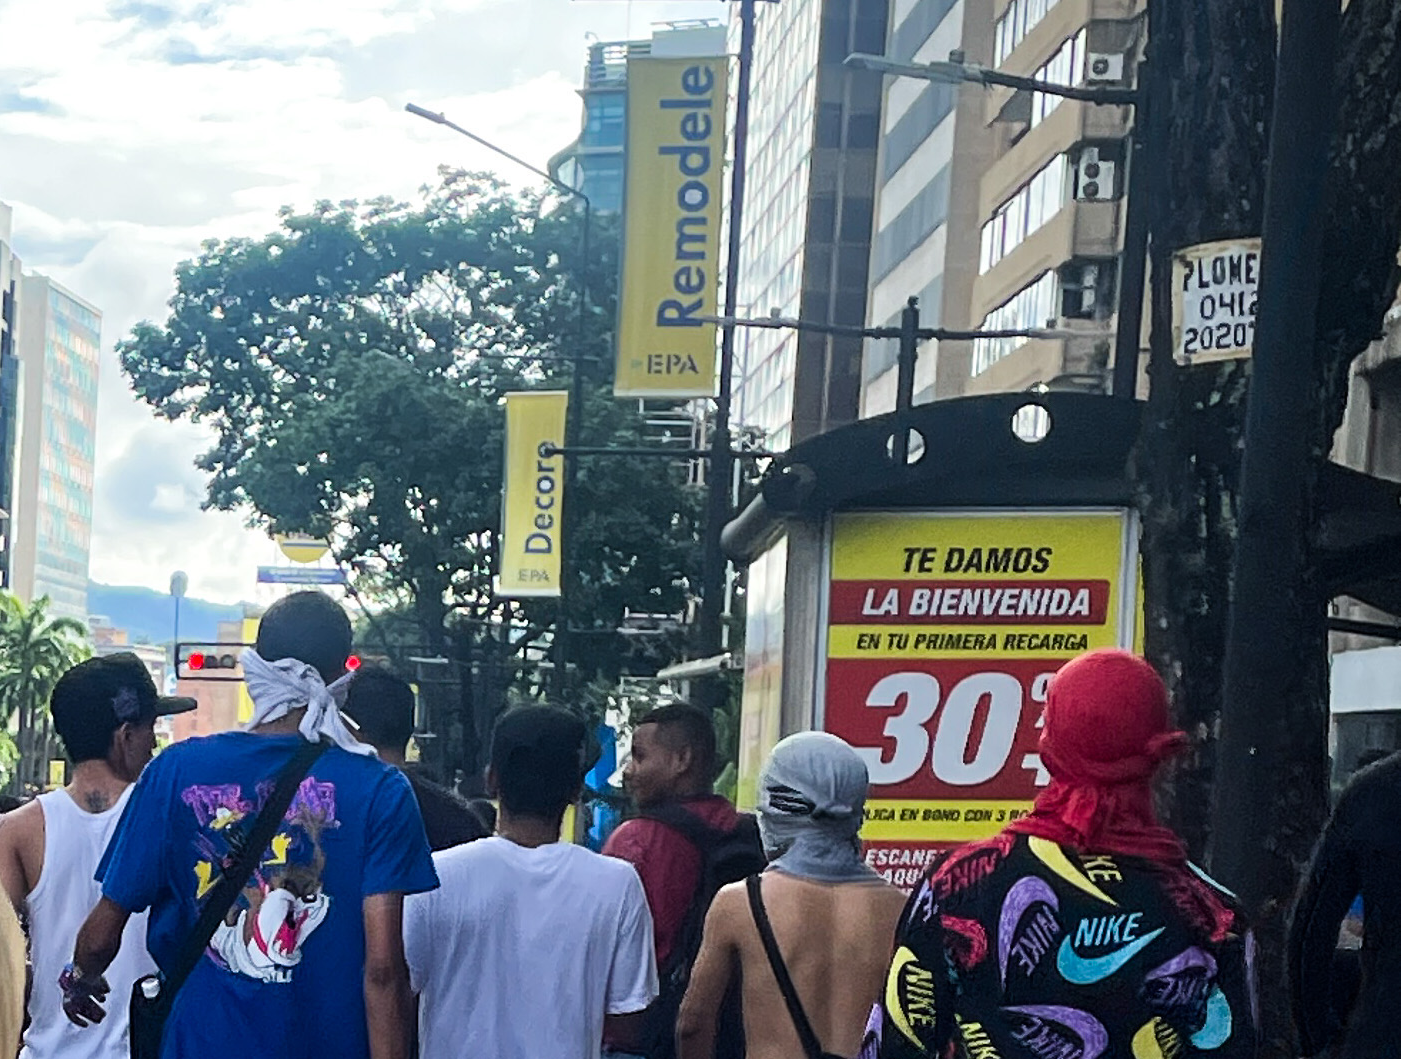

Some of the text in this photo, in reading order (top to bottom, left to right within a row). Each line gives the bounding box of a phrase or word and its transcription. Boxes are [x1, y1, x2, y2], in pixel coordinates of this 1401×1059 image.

[656, 65, 714, 327] Remodele
[1182, 254, 1257, 291] PLOME
[647, 354, 699, 374] EPA
[903, 547, 1053, 573] TE DAMOS
[518, 569, 550, 582] EPA
[862, 588, 1090, 616] LA BIENVENIDA
[857, 633, 1089, 650] EN TU PRIMERA RECARGA
[900, 808, 919, 821] EN
[1011, 905, 1061, 976] NIKE
[1074, 912, 1144, 947] NIKE
[905, 963, 937, 1027] NIKE
